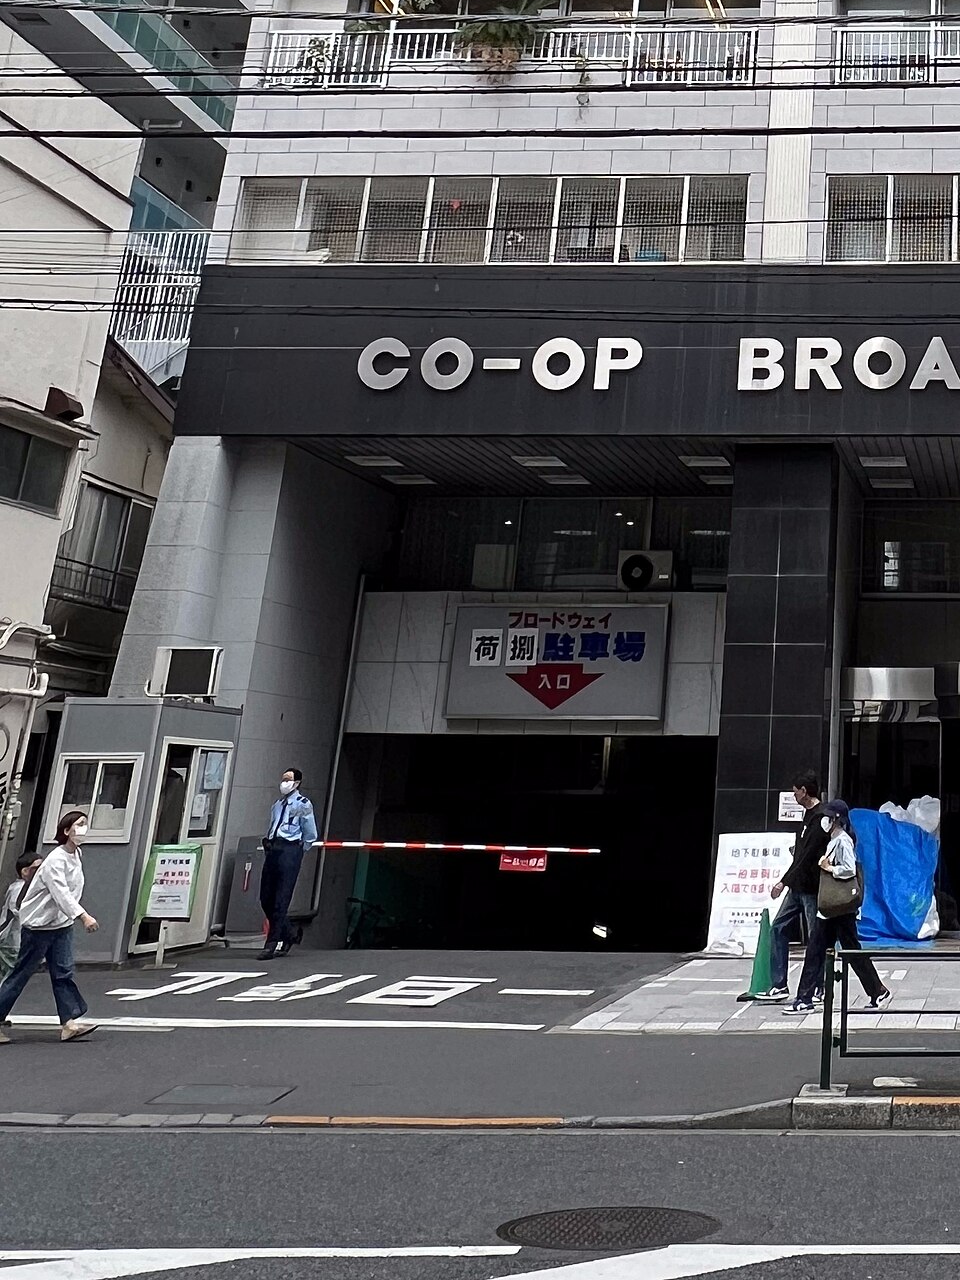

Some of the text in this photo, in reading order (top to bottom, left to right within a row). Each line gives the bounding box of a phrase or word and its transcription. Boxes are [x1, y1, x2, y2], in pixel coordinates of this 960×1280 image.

[357, 336, 643, 391] CO-OP
[508, 611, 612, 629] ブロードウェイ
[538, 674, 570, 690] 入口
